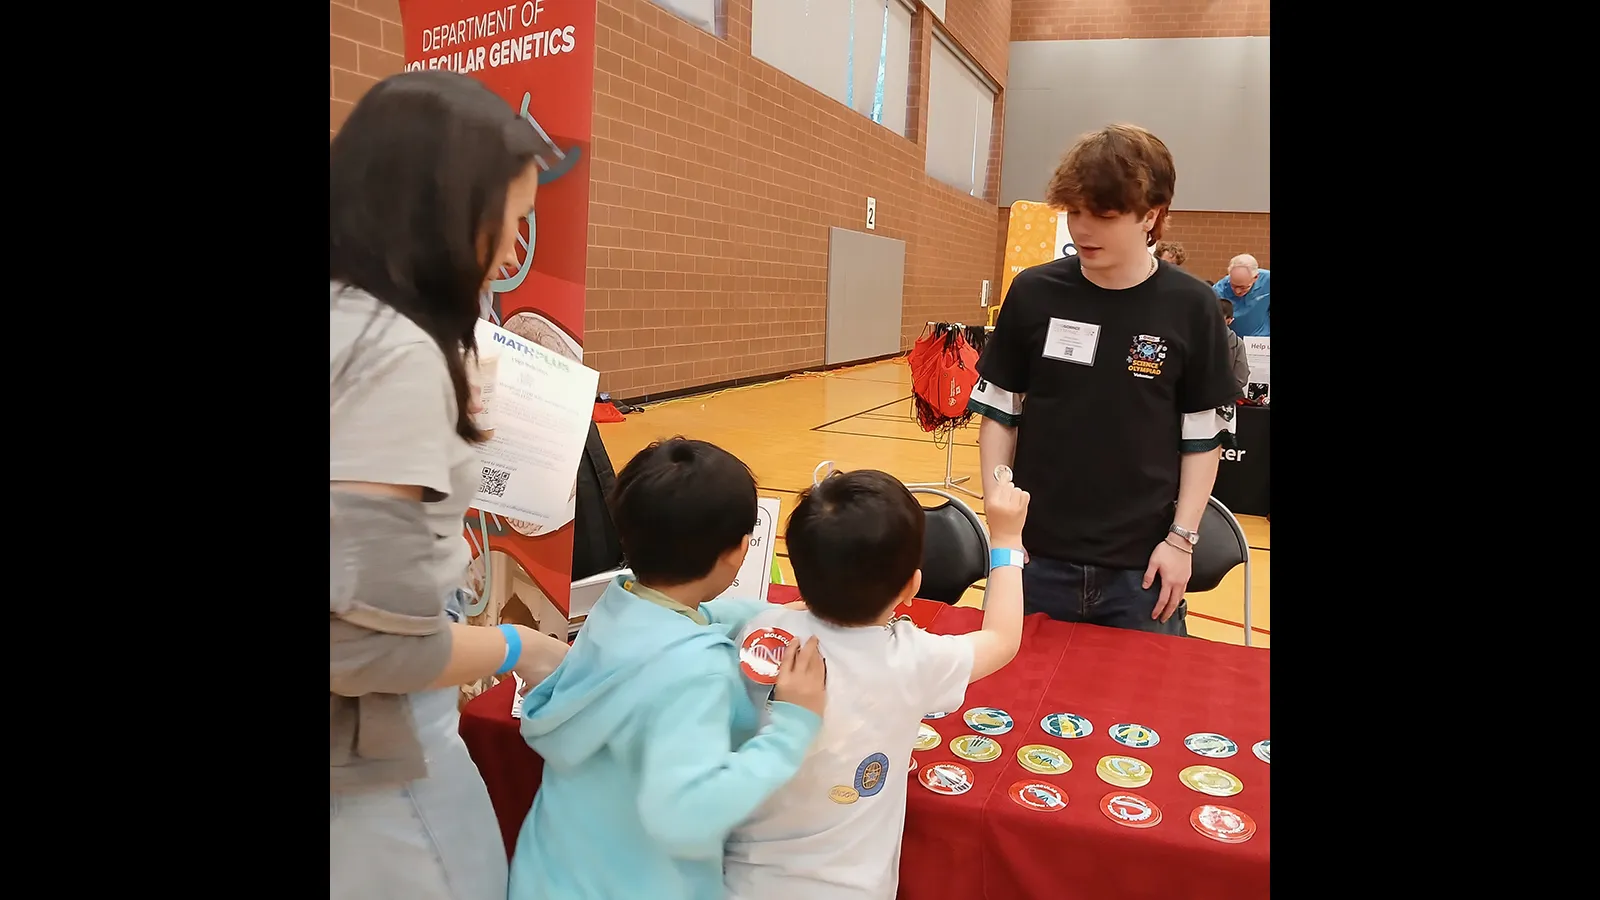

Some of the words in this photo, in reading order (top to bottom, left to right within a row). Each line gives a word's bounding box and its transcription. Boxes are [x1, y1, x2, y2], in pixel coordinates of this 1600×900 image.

[422, 5, 516, 52] DEPARTMENT
[521, 0, 544, 26] OF
[489, 25, 576, 67] GENETICS
[868, 207, 874, 225] 2
[1128, 365, 1161, 375] OLYMPIAD
[1132, 359, 1159, 369] SCIENCE
[750, 536, 762, 547] of
[764, 633, 790, 646] MOLECU
